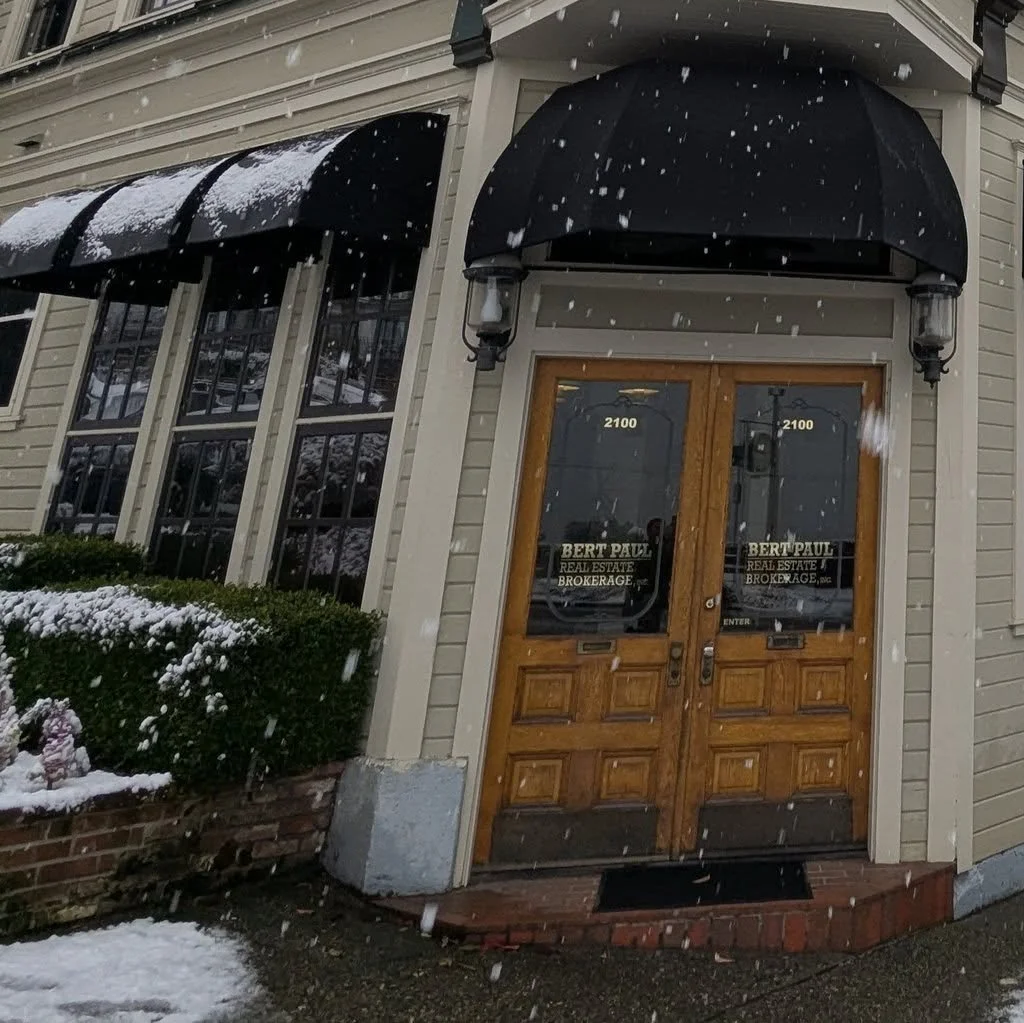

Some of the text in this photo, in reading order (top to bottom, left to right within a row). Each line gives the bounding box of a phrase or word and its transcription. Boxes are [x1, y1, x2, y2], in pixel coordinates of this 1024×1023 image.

[604, 417, 637, 428] 2100
[783, 419, 814, 430] 2100
[561, 543, 652, 558] BERT PAUL
[748, 542, 833, 556] BERT PAUL
[560, 562, 634, 573] REAL ESTATE
[747, 560, 817, 571] REAL ESTATE
[723, 618, 750, 626] ENTER
